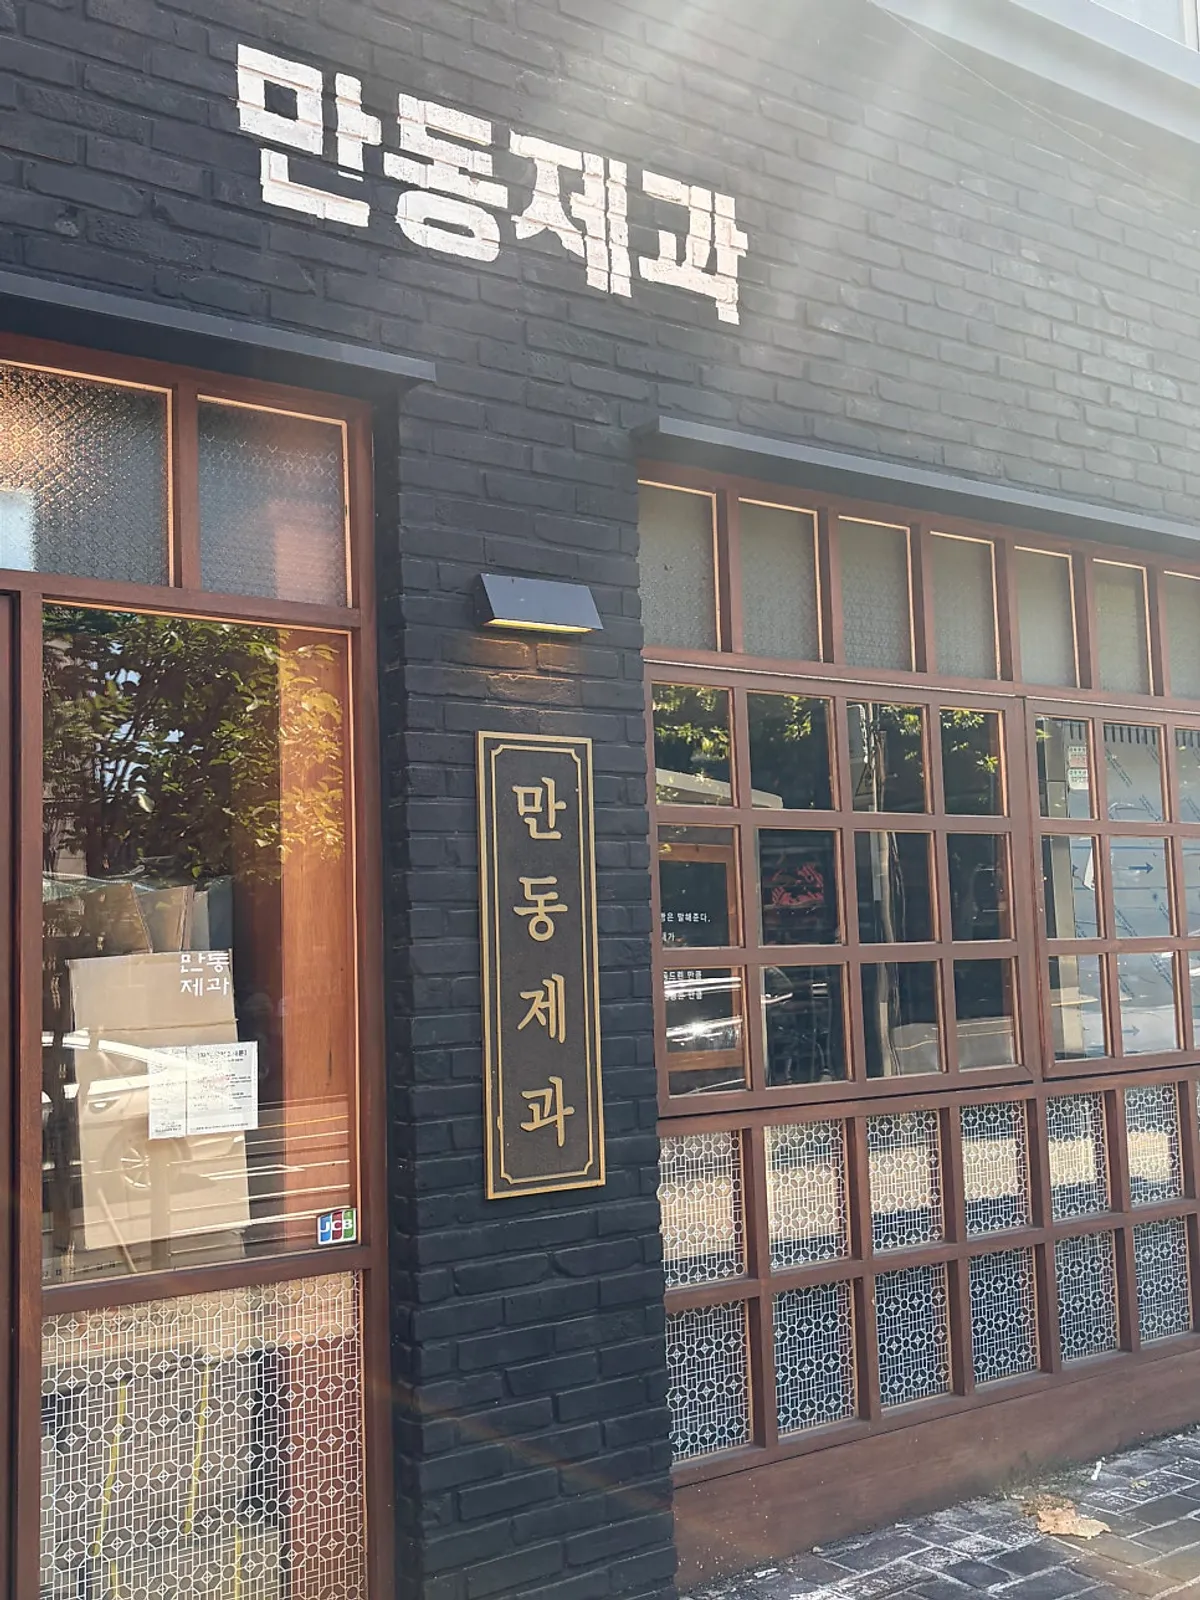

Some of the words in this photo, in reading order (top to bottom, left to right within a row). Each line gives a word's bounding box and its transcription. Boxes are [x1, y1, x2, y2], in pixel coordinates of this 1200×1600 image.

[237, 43, 748, 325] 만동제과
[180, 952, 230, 973] 만동
[180, 977, 230, 996] 제과
[512, 776, 575, 1147] 만동제과
